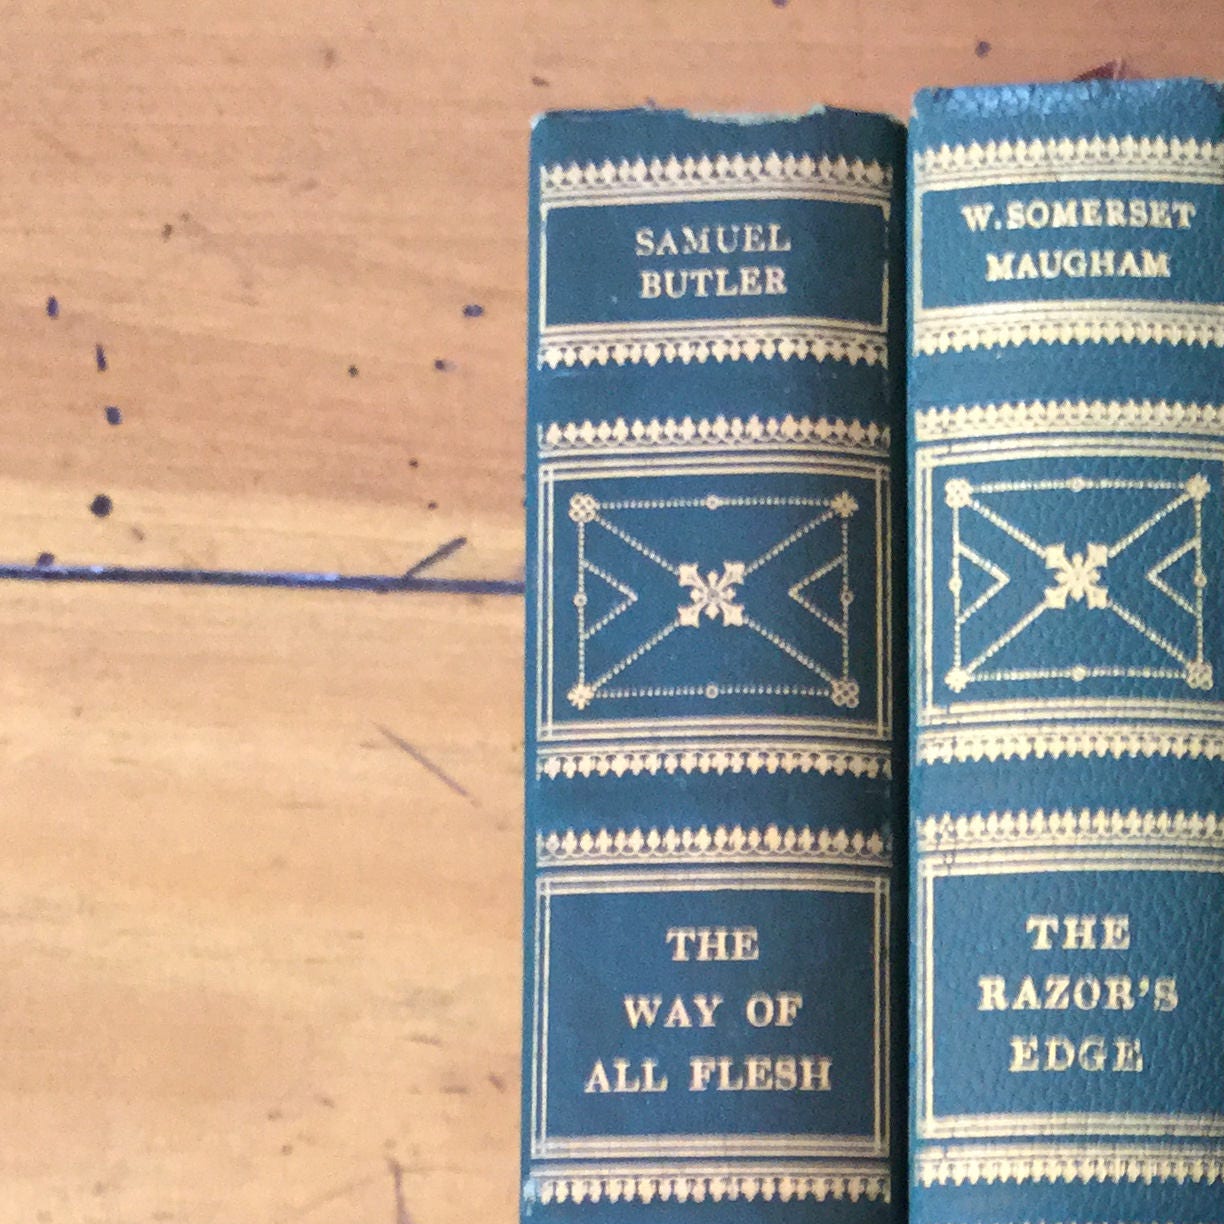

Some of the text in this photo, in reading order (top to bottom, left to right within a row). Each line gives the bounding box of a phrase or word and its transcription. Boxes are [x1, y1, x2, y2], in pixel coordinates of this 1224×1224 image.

[635, 224, 792, 256] SAMUEL
[638, 267, 788, 299] BUTLER
[985, 250, 1171, 281] MAUGHAM
[665, 925, 760, 961] THE
[1026, 913, 1131, 950] THE
[623, 991, 803, 1029] WAY OF
[977, 974, 1179, 1011] RAZOR'S
[1008, 1034, 1144, 1072] EDGE
[584, 1055, 833, 1093] ALL FLESH
